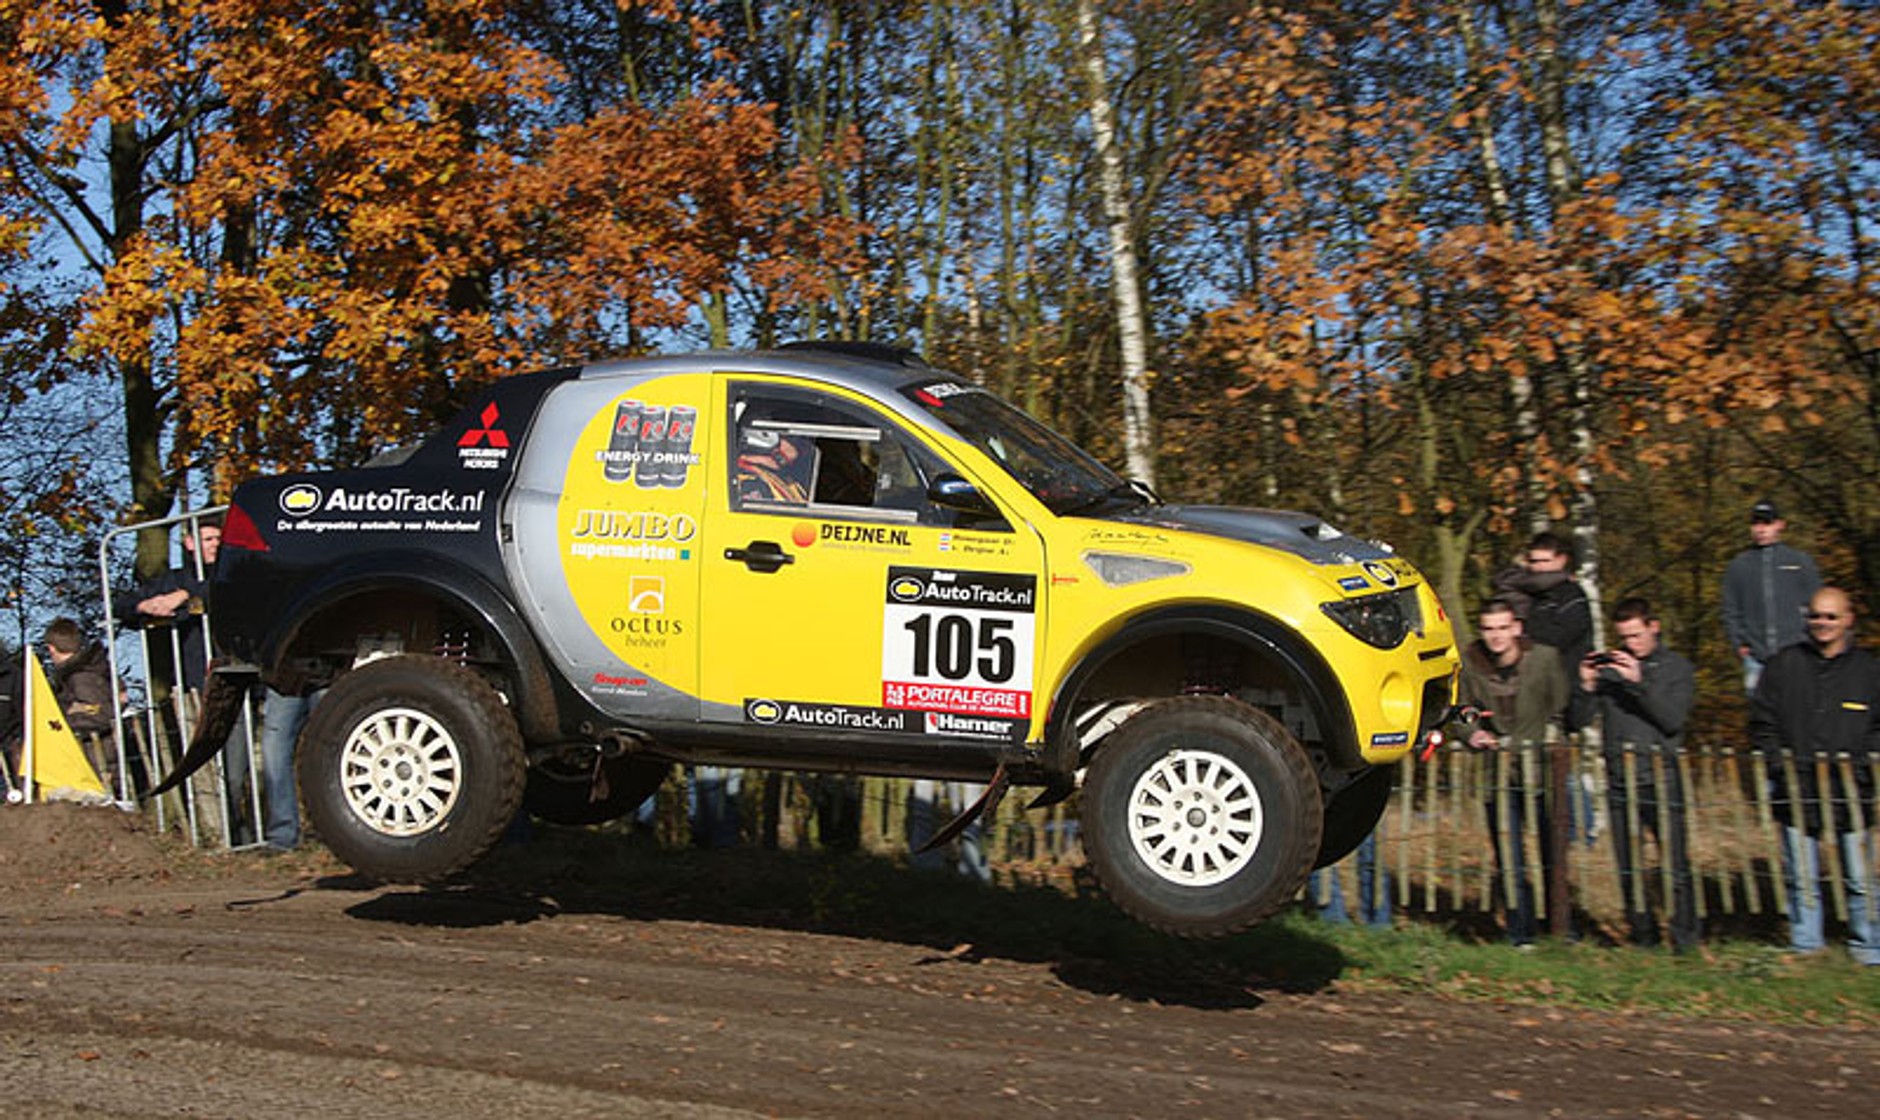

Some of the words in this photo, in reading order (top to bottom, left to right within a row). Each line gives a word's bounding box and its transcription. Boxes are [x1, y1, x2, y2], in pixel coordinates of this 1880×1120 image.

[596, 450, 649, 463] ENERGY
[653, 452, 700, 465] DRINK
[324, 488, 485, 512] AutoTrack.nl
[572, 509, 697, 542] JUMBO
[821, 523, 912, 546] DEIJNE.NL
[925, 581, 1032, 605] AutoTrack.nl
[611, 617, 683, 635] octus
[904, 613, 1015, 684] 105
[907, 685, 1017, 706] PORTALEGRE
[784, 704, 904, 730] AutoTrack.nl
[939, 713, 1014, 734] Hamer
